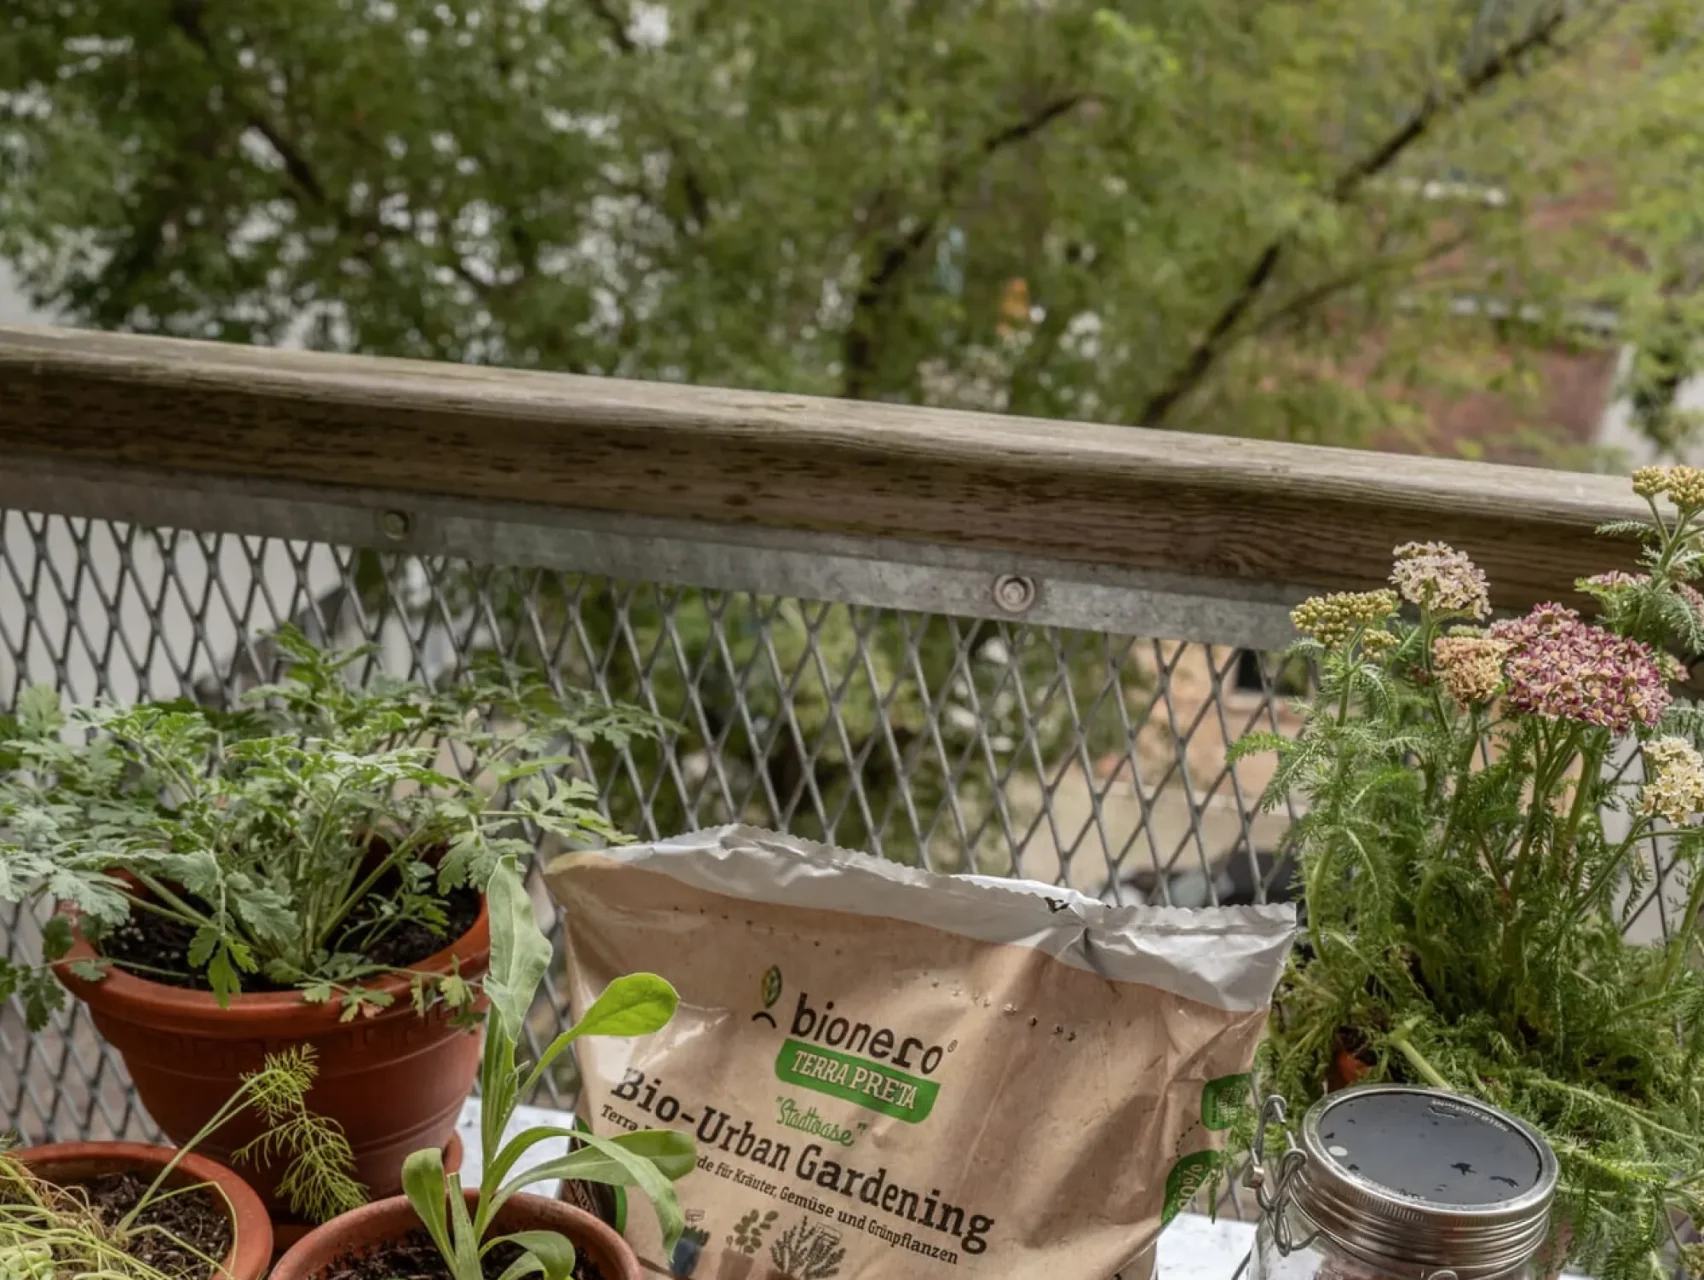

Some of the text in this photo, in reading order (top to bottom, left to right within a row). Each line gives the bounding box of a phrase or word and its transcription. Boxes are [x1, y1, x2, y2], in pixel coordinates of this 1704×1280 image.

[791, 1050, 918, 1109] TERRA PRETA
[600, 1103, 638, 1131] Terra
[714, 1162, 734, 1179] für
[732, 1168, 777, 1198] Kräuter,
[779, 1186, 834, 1218] Gemüse
[837, 1210, 867, 1230] und
[868, 1219, 958, 1265] Grünpflanzen
[610, 1067, 995, 1255] Bio-Urban Gardening
